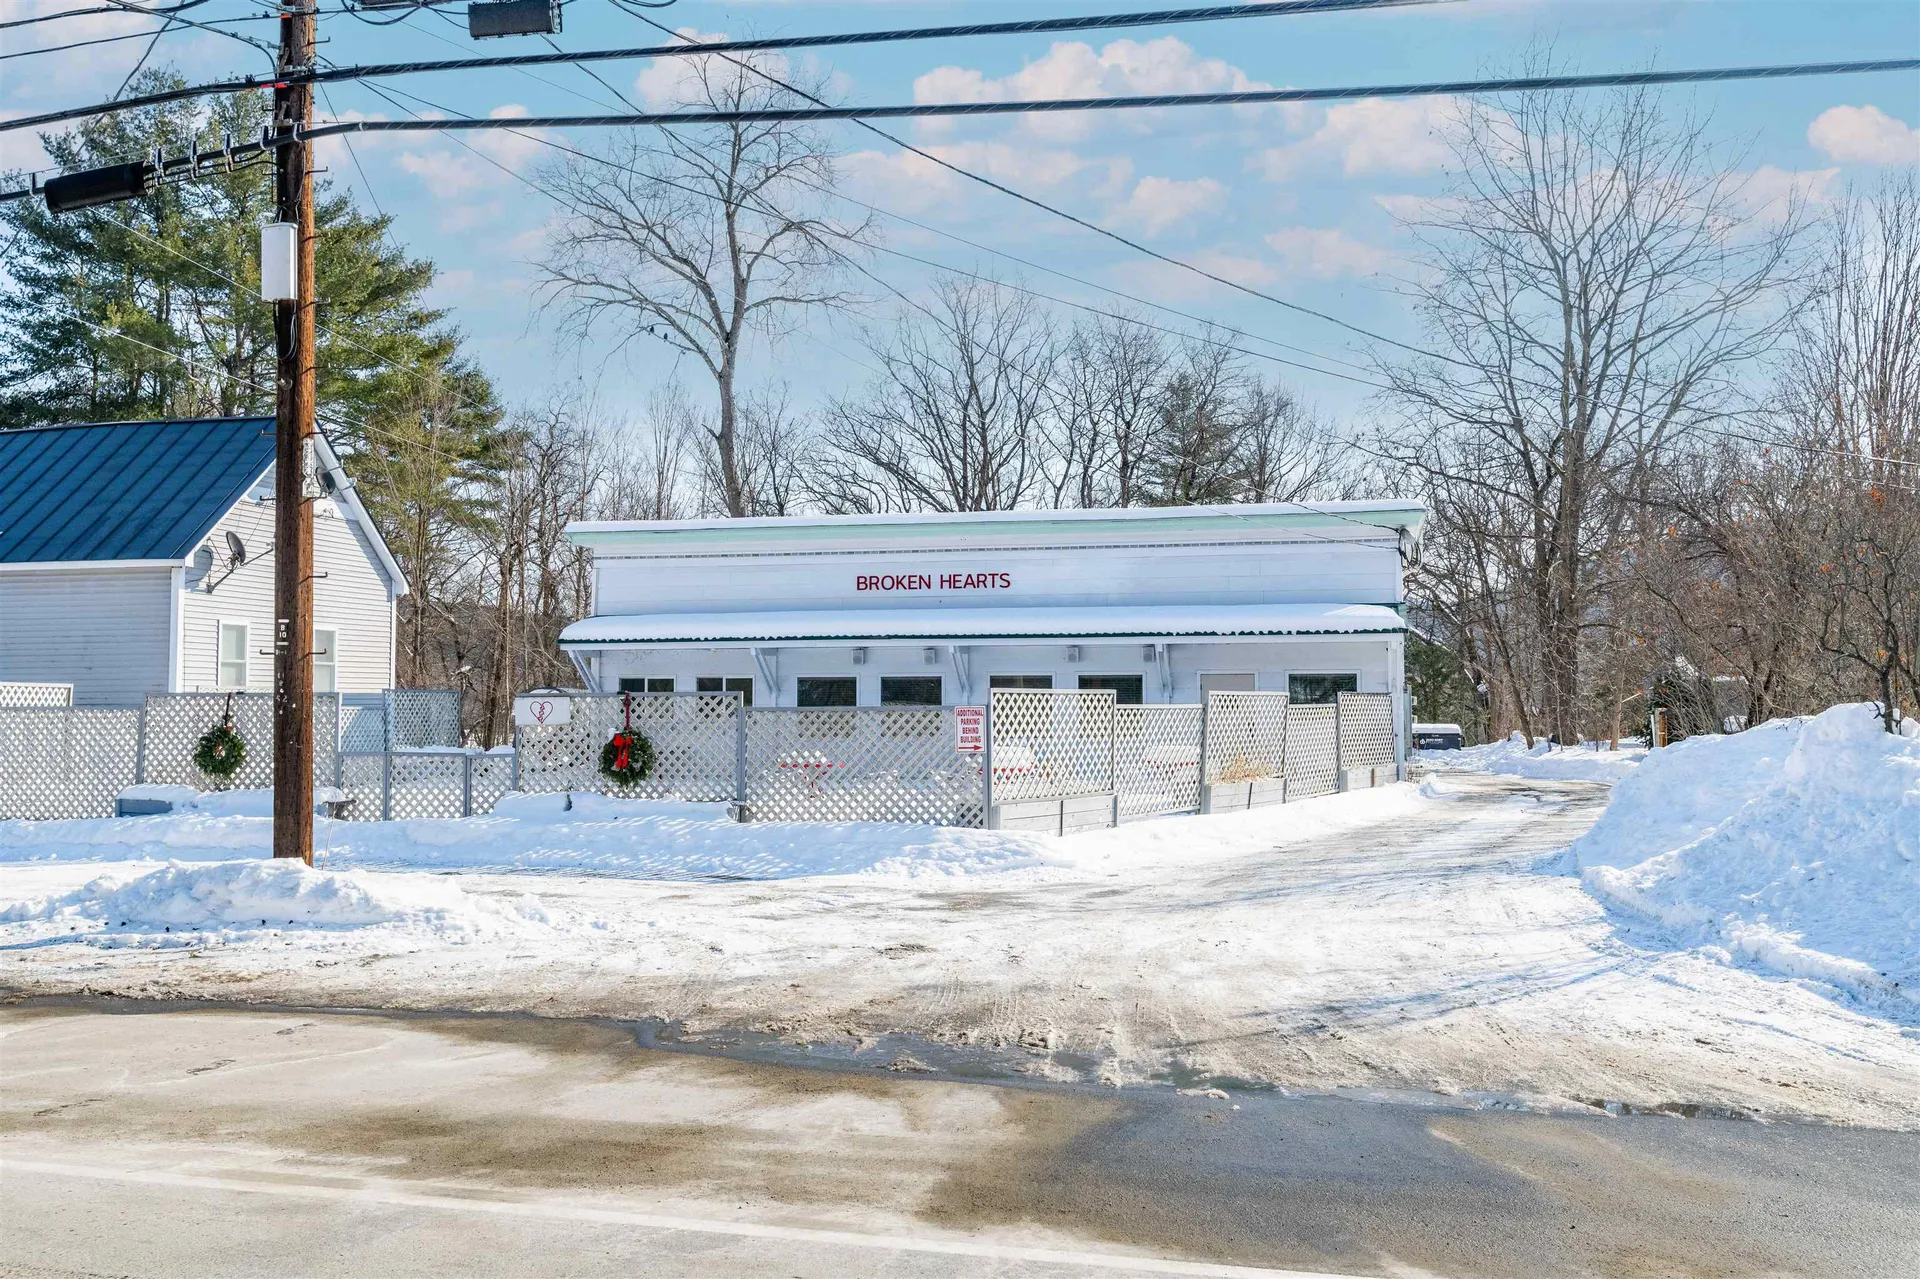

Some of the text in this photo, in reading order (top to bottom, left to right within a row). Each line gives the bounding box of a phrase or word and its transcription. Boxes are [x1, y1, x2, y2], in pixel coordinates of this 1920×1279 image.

[856, 573, 1011, 591] BROKEN HEARTS
[957, 709, 984, 717] ADDITIONAL
[960, 718, 981, 726] PARKING
[962, 727, 979, 735] BEHIND
[960, 736, 982, 744] BUILDING
